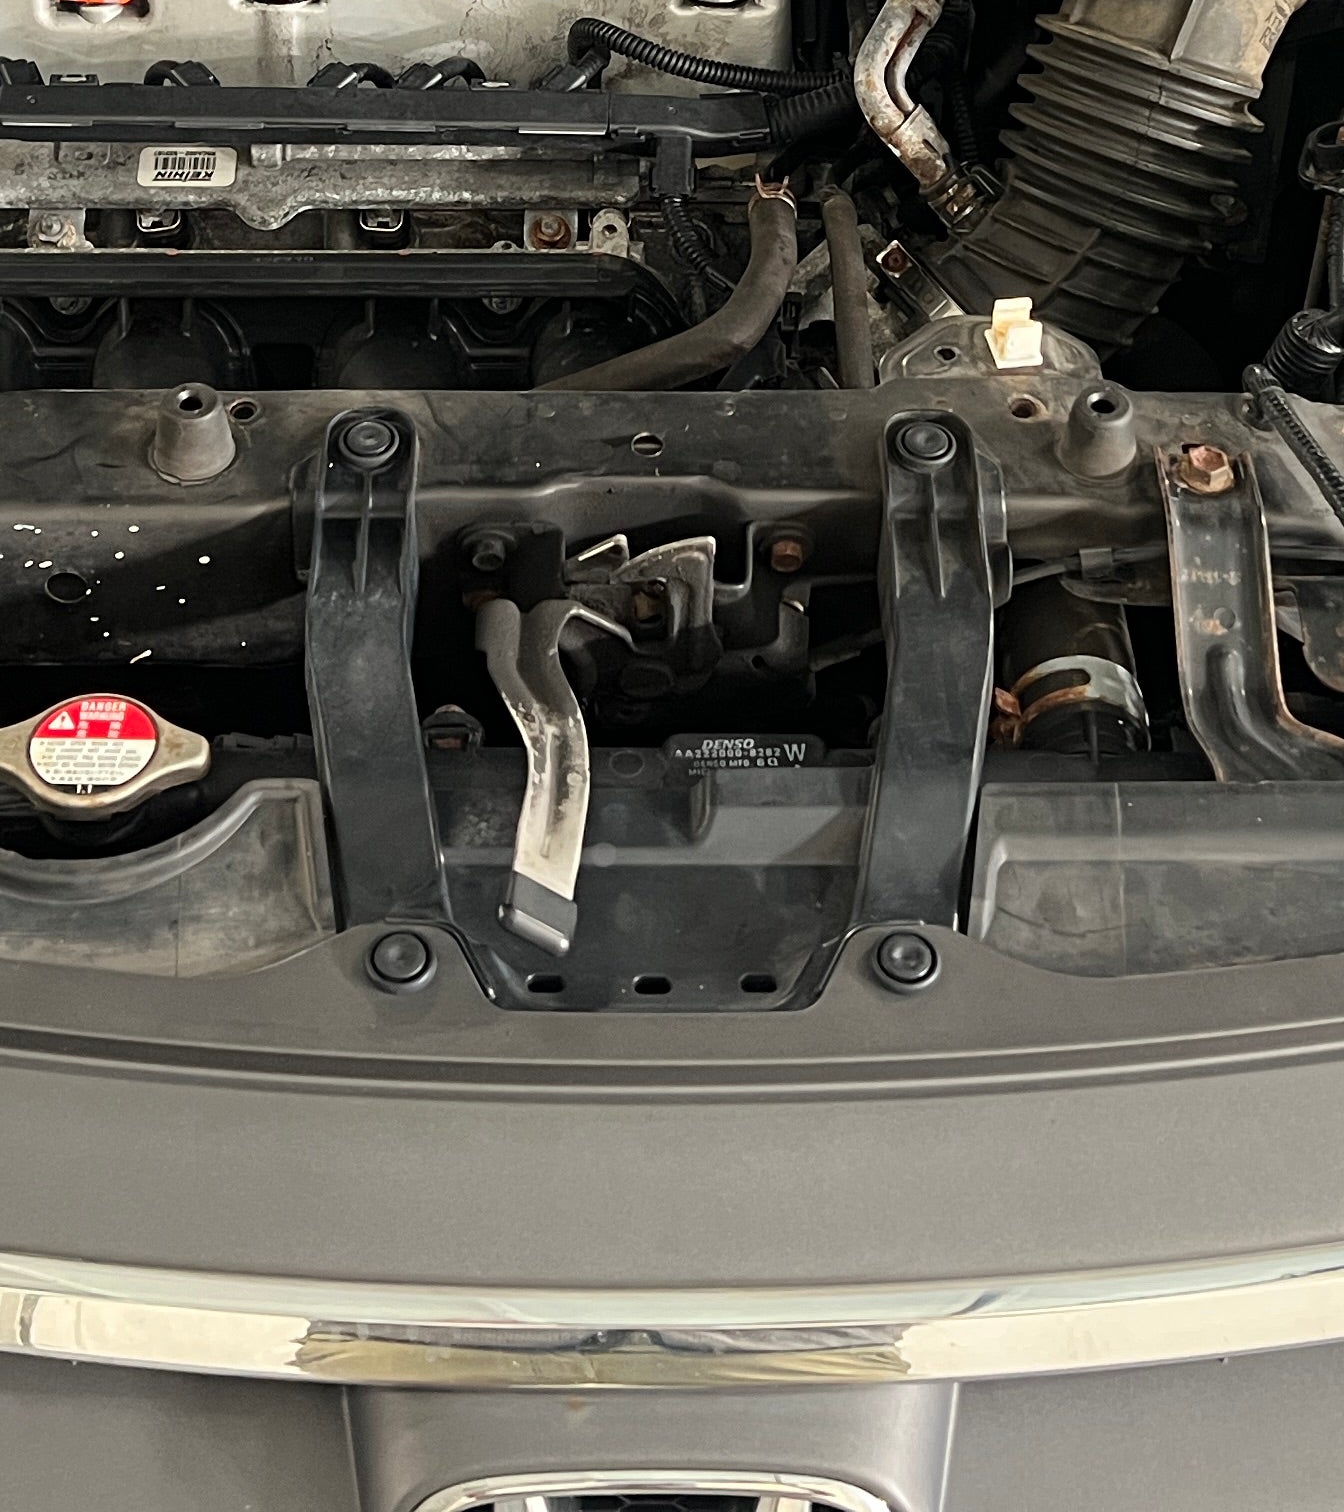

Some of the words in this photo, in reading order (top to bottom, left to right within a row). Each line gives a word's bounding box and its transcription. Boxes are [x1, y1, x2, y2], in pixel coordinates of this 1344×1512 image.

[153, 171, 214, 181] KEIHIN
[80, 701, 127, 711] DANGER
[701, 738, 754, 750] DENSO
[783, 743, 805, 761] W
